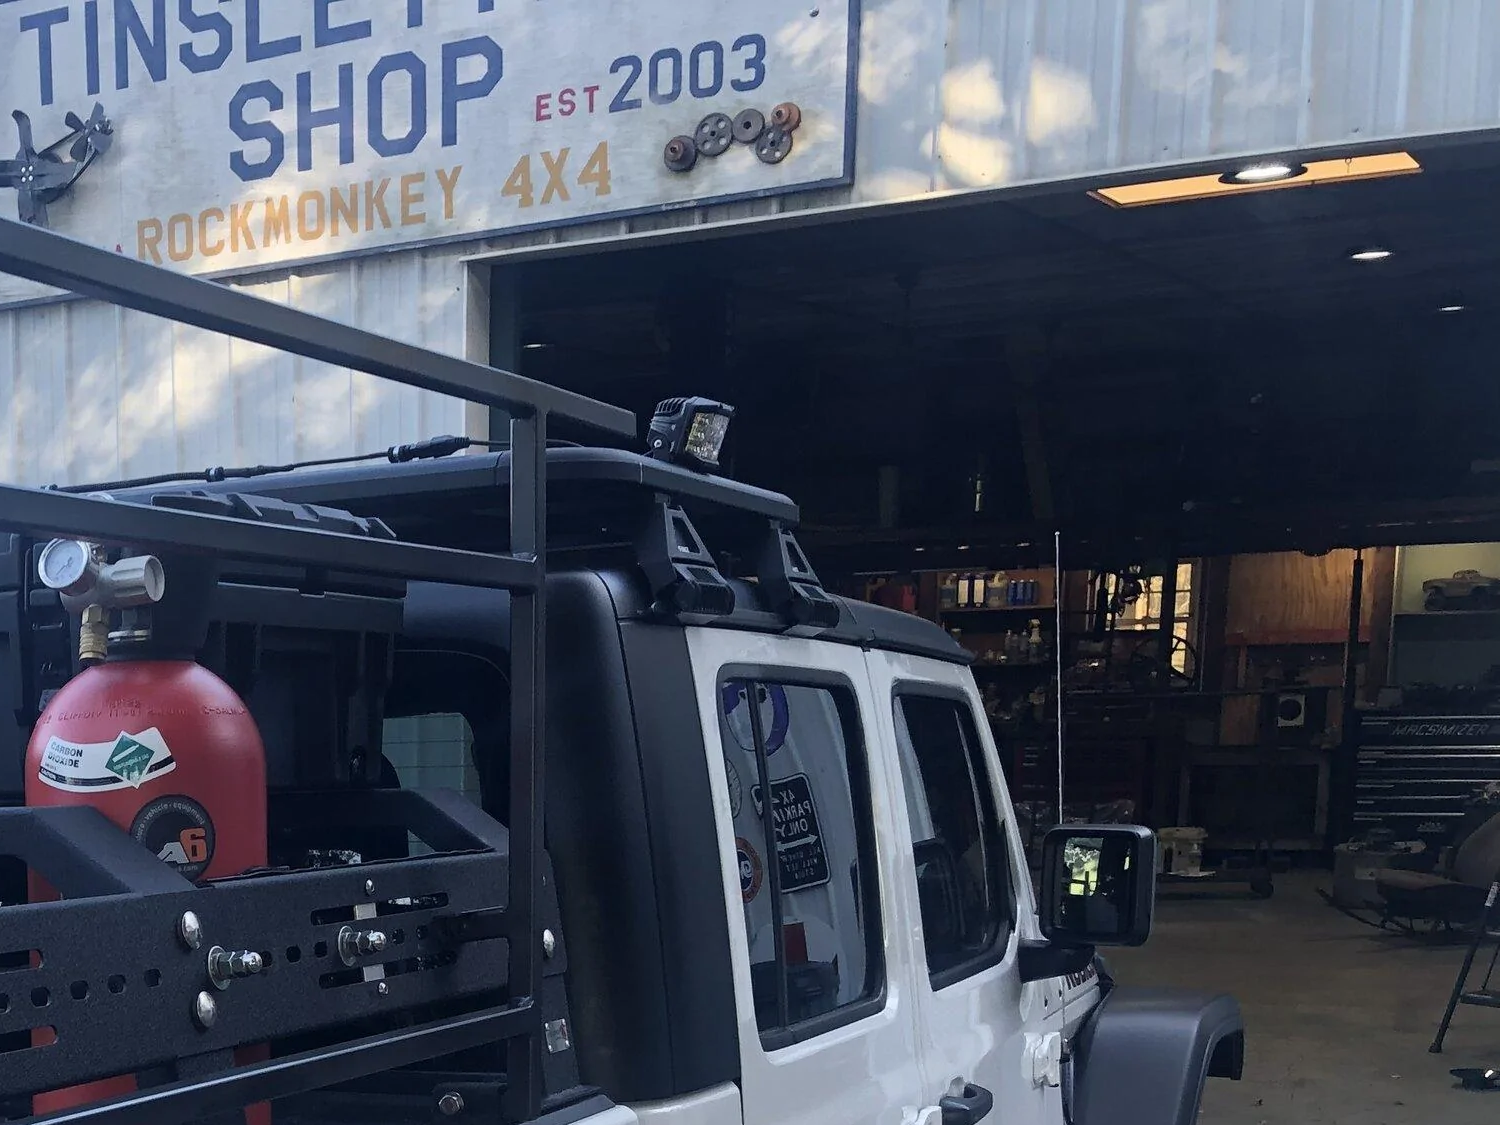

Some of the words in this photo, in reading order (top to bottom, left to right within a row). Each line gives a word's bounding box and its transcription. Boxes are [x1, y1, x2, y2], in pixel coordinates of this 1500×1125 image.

[229, 35, 503, 182] SHOP
[535, 85, 600, 122] EST
[608, 33, 767, 114] 2003
[137, 165, 463, 266] ROCKMONKEY
[501, 140, 612, 208] 4X4
[47, 751, 80, 768] DIOXIDE
[51, 741, 83, 757] CARBON
